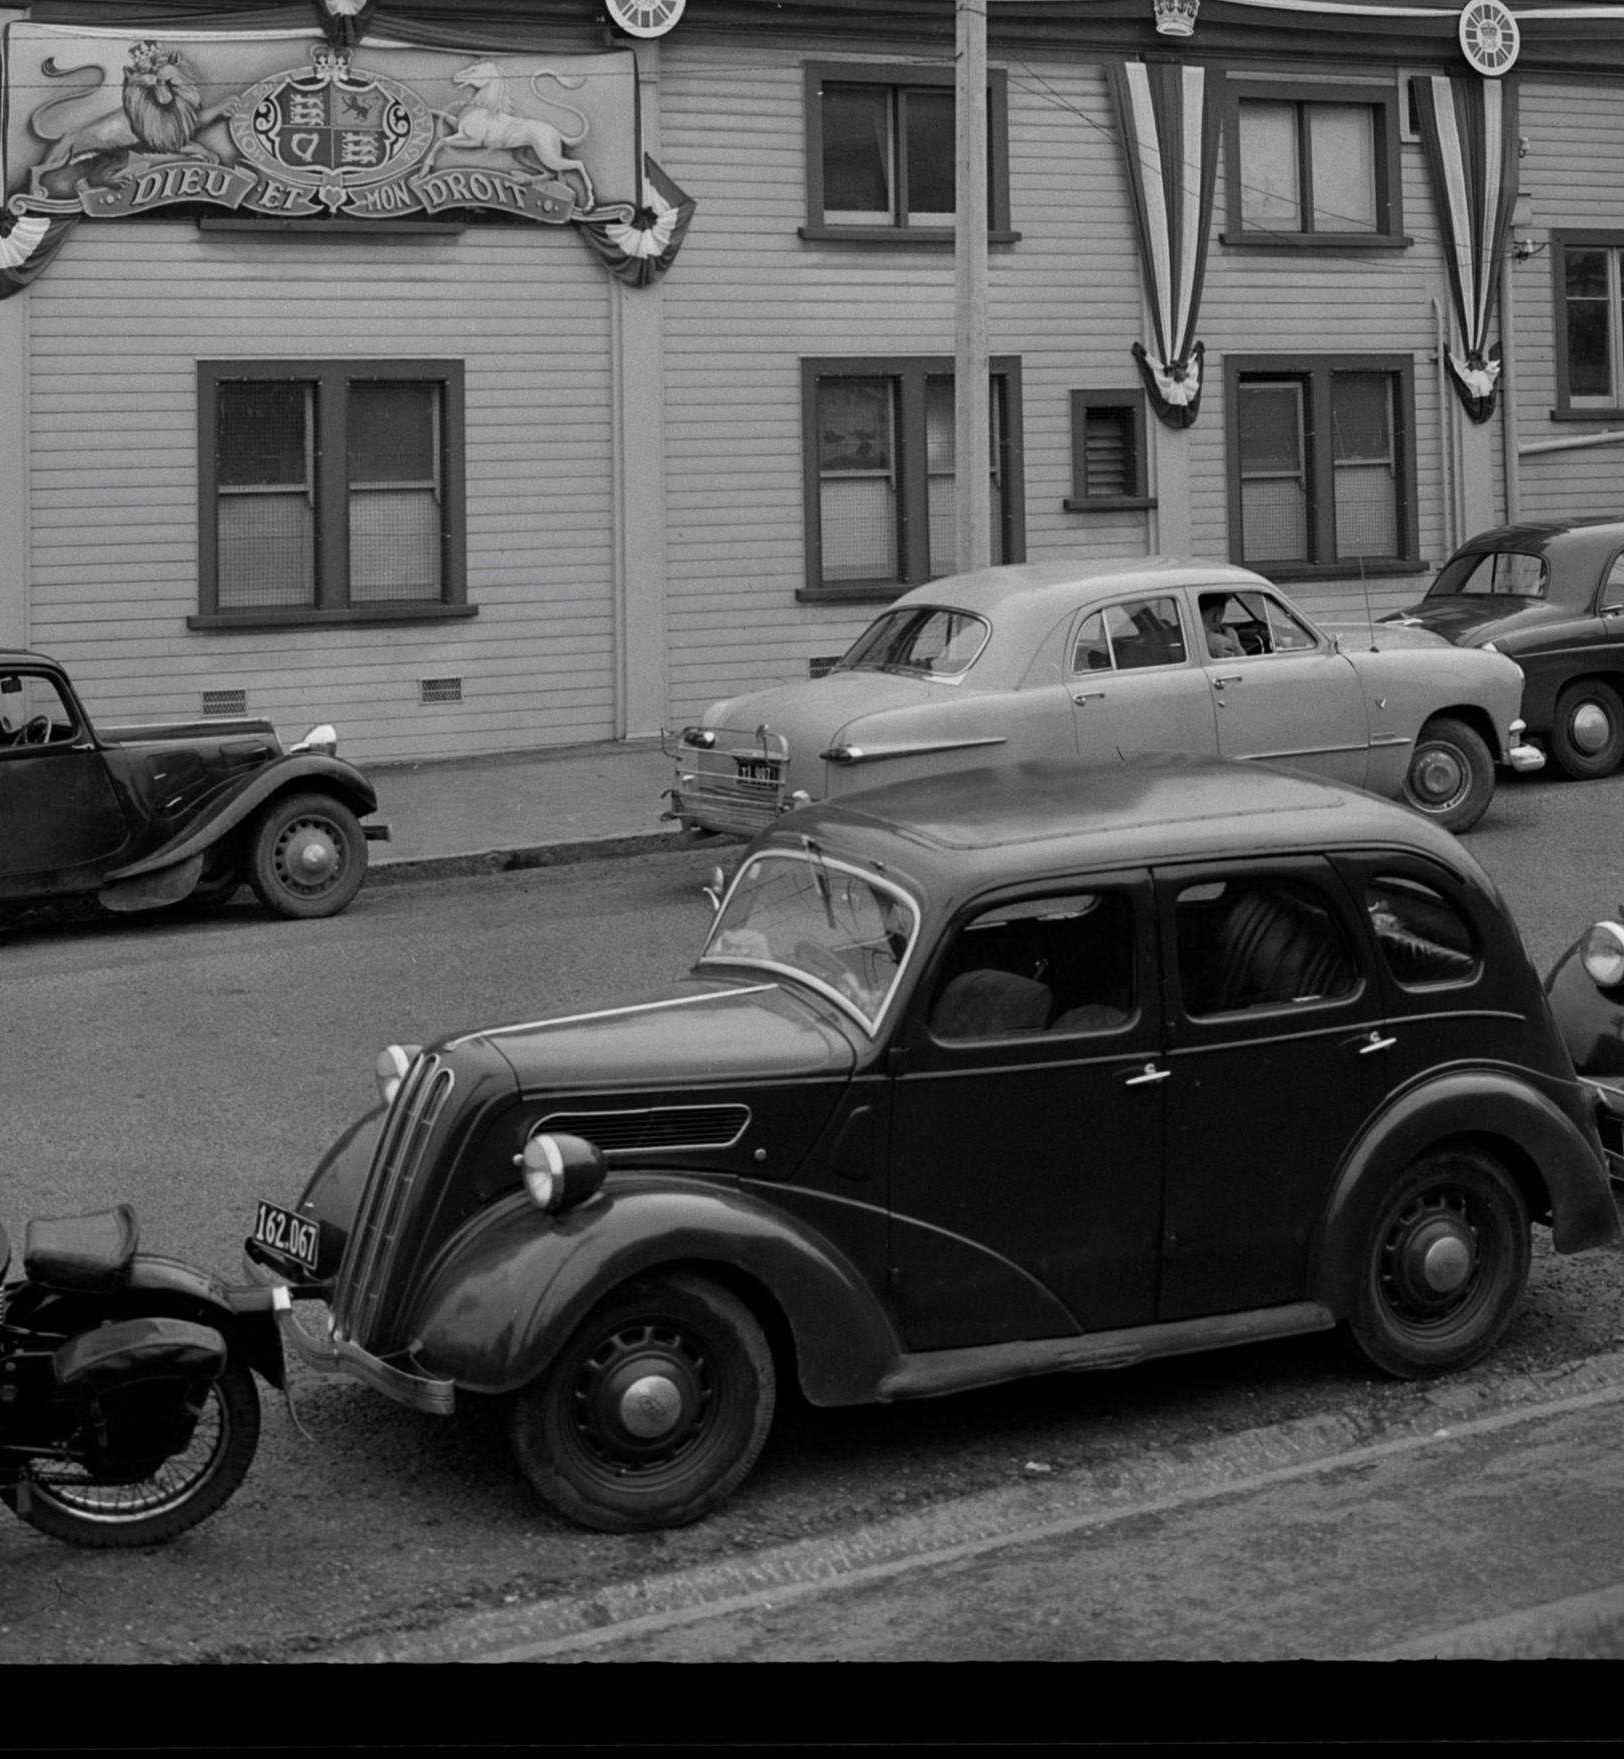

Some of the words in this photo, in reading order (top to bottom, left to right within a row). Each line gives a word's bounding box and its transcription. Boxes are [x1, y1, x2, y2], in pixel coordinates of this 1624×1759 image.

[131, 167, 233, 206] DIEU
[259, 179, 305, 210] ET
[364, 178, 411, 211] MON
[422, 168, 528, 209] DROIT
[256, 1204, 317, 1262] 162.067
